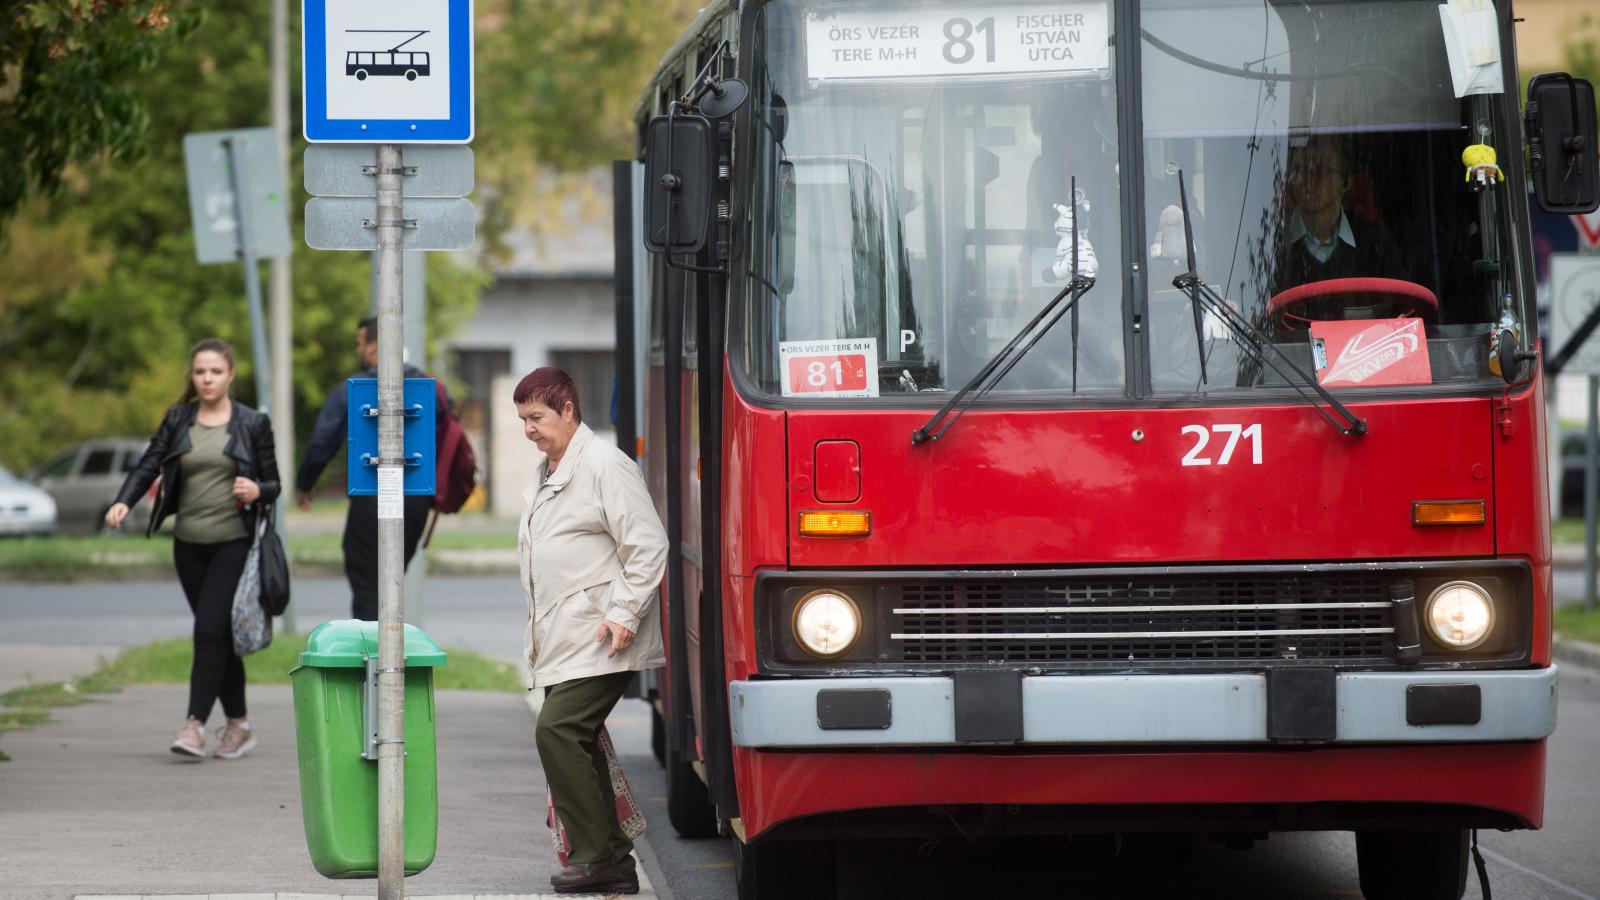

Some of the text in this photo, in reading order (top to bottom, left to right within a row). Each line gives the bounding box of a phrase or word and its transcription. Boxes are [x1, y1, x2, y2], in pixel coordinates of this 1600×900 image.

[1016, 13, 1084, 29] FISCHER
[867, 22, 919, 40] VEZÉR
[942, 16, 996, 64] 81
[1020, 27, 1081, 45] ISTVÁN
[832, 46, 917, 62] TERE M+H
[1028, 47, 1074, 61] UTCA
[832, 343, 852, 352] TERE
[900, 329, 916, 353] P
[807, 360, 843, 387] 81
[1181, 423, 1262, 467] 271
